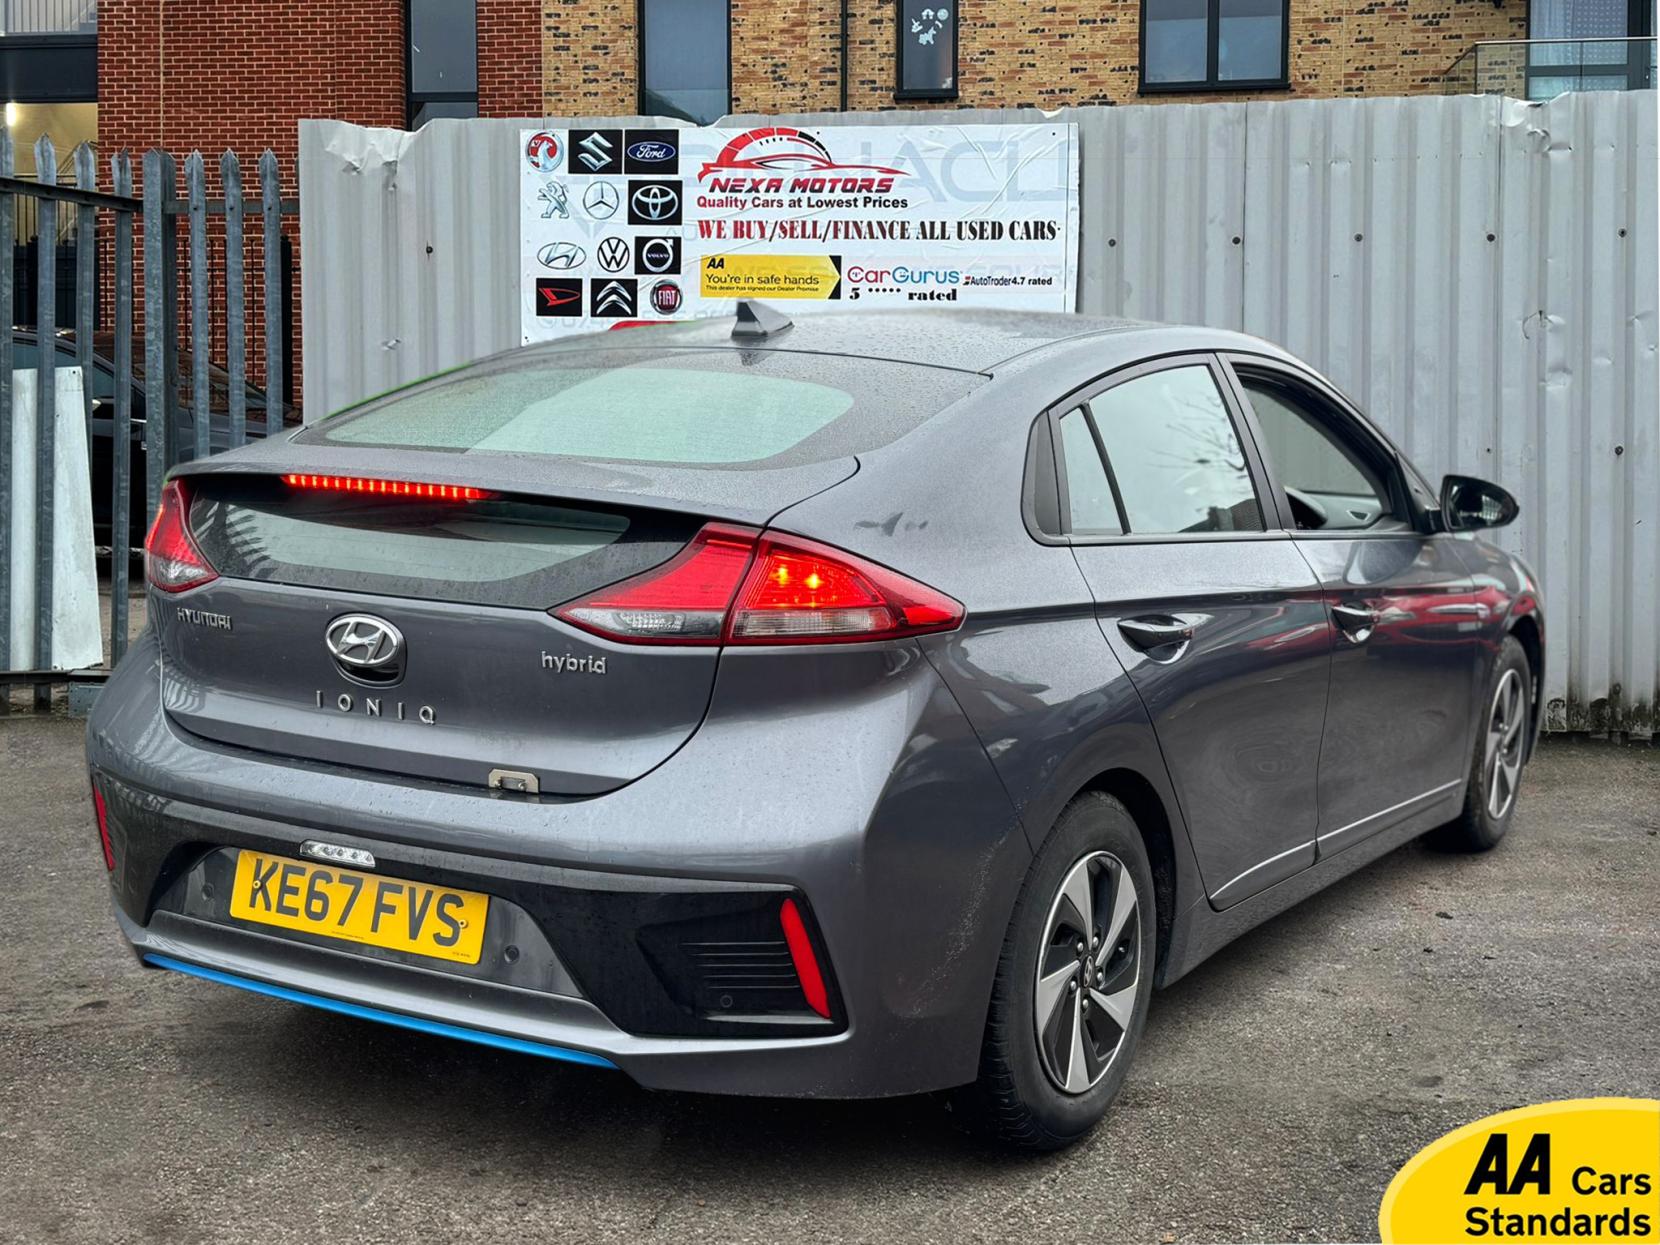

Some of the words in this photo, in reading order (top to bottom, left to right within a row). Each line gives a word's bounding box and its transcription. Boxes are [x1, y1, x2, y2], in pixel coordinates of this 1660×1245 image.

[636, 144, 666, 159] Ford
[708, 177, 783, 194] NEXA
[789, 177, 895, 194] MOTORS
[696, 195, 747, 210] Quality
[752, 196, 784, 208] Cars
[788, 196, 803, 208] at
[807, 195, 859, 208] Lowest
[863, 195, 909, 209] Prices
[697, 219, 727, 240] WE
[916, 220, 950, 241] ALL
[956, 220, 1004, 241] USED
[1009, 220, 1057, 241] CARS
[706, 257, 725, 270] AA
[706, 273, 741, 284] You're
[744, 273, 755, 284] in
[757, 274, 781, 285] safe
[784, 275, 820, 285] hands
[847, 266, 960, 284] CarGurus
[970, 275, 1011, 286] AutoTrader
[1011, 277, 1026, 286] 4.7
[1028, 276, 1053, 286] rated
[658, 290, 677, 306] FIAT
[849, 287, 860, 300] 5
[908, 288, 957, 301] rated
[176, 607, 234, 631] HYUNDAI
[541, 650, 607, 675] hybrid
[316, 690, 437, 726] IONIQ
[249, 857, 365, 928] KE67
[369, 879, 465, 948] FVS
